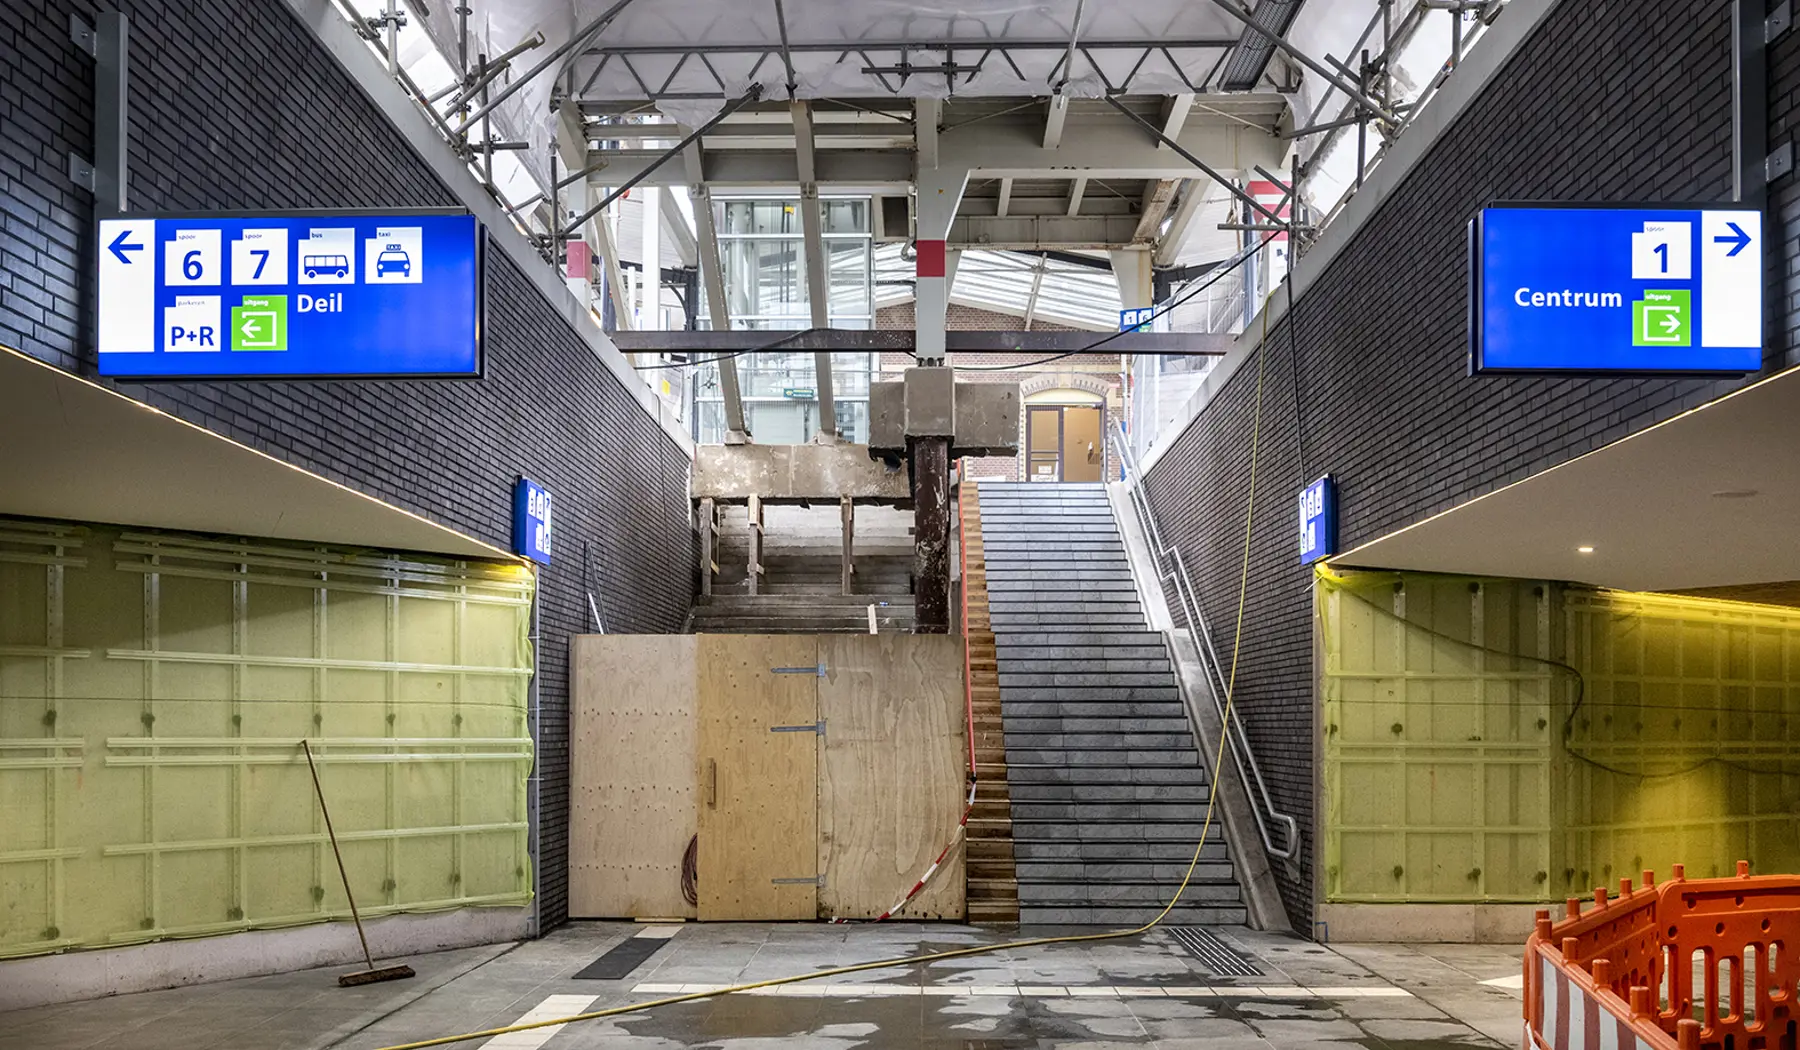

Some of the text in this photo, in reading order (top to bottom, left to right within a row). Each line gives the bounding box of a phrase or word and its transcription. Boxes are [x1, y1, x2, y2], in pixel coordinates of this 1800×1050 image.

[182, 250, 203, 280] 6
[249, 250, 270, 279] 7
[1653, 243, 1668, 273] 1
[297, 294, 343, 313] Deil
[1515, 287, 1622, 307] Centrum
[171, 326, 214, 346] P+R
